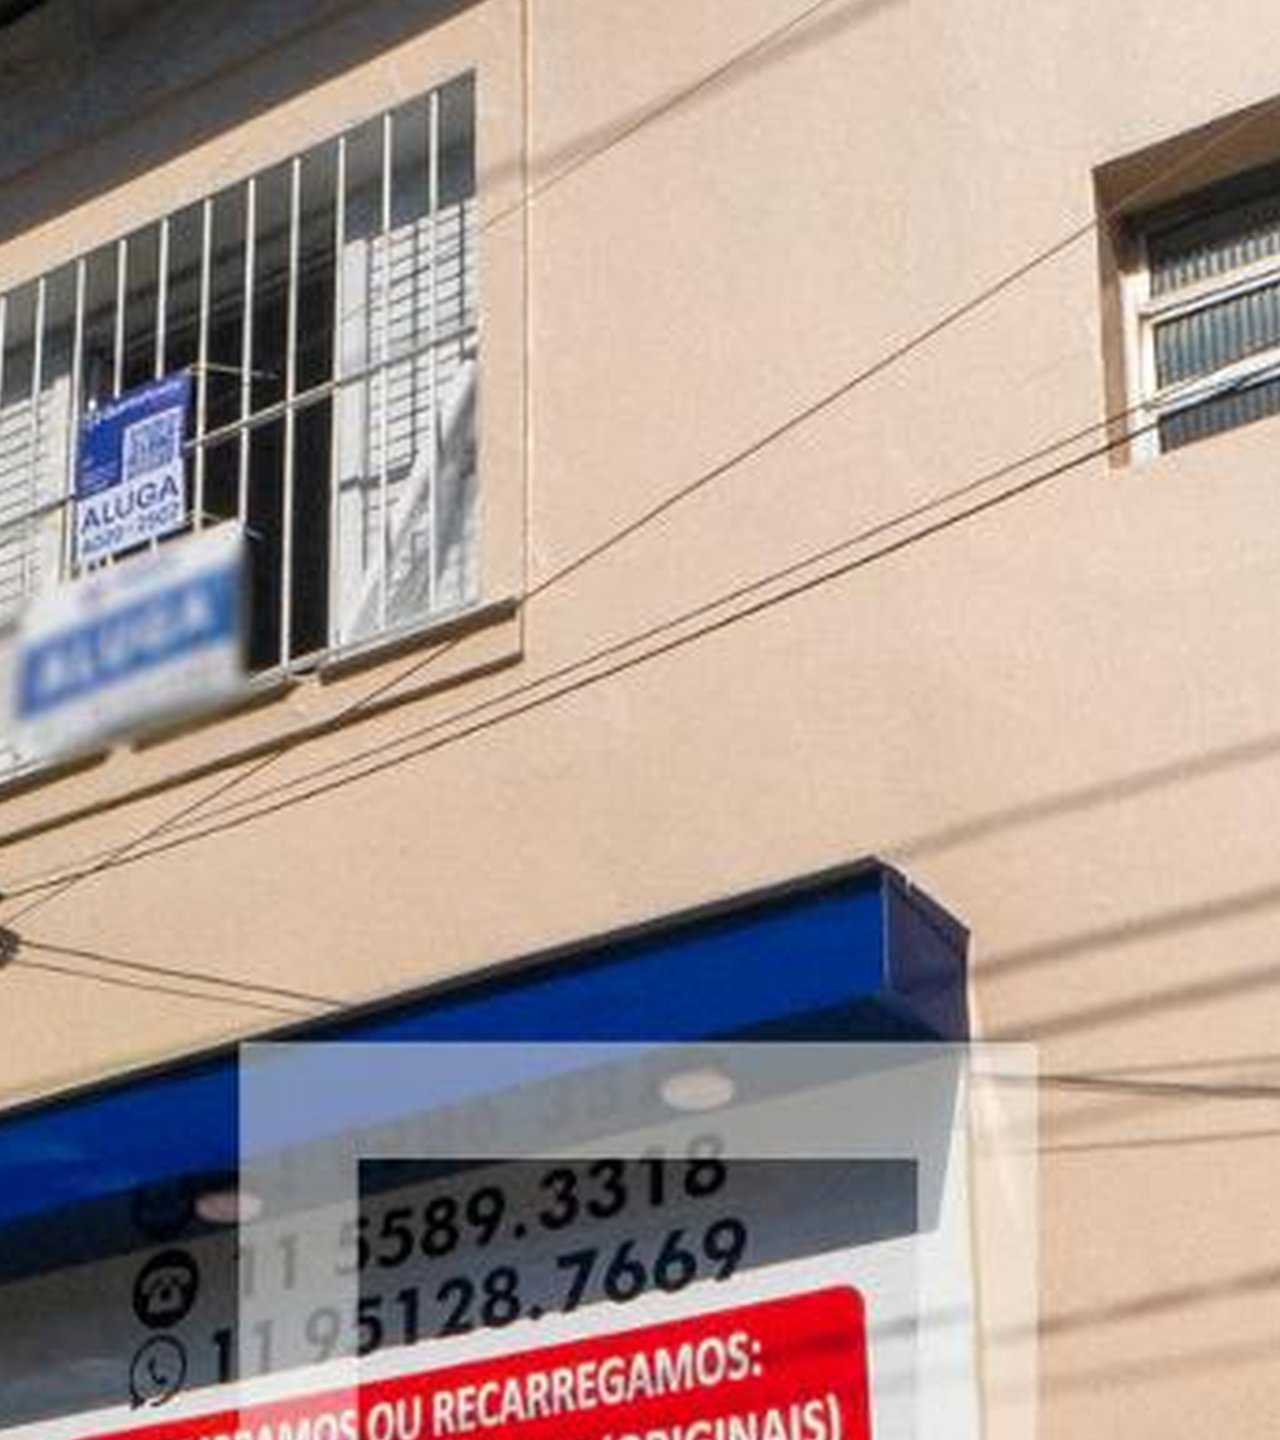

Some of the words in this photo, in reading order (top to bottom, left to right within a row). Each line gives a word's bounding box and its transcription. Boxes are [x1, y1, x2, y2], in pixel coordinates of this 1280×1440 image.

[80, 475, 180, 535] ALUGA
[233, 1234, 298, 1298] 11
[334, 1134, 727, 1276] 5589.3318
[213, 1320, 273, 1383] 11
[306, 1217, 748, 1362] 95128.7669
[432, 1331, 763, 1437] RECARREGAMOS:
